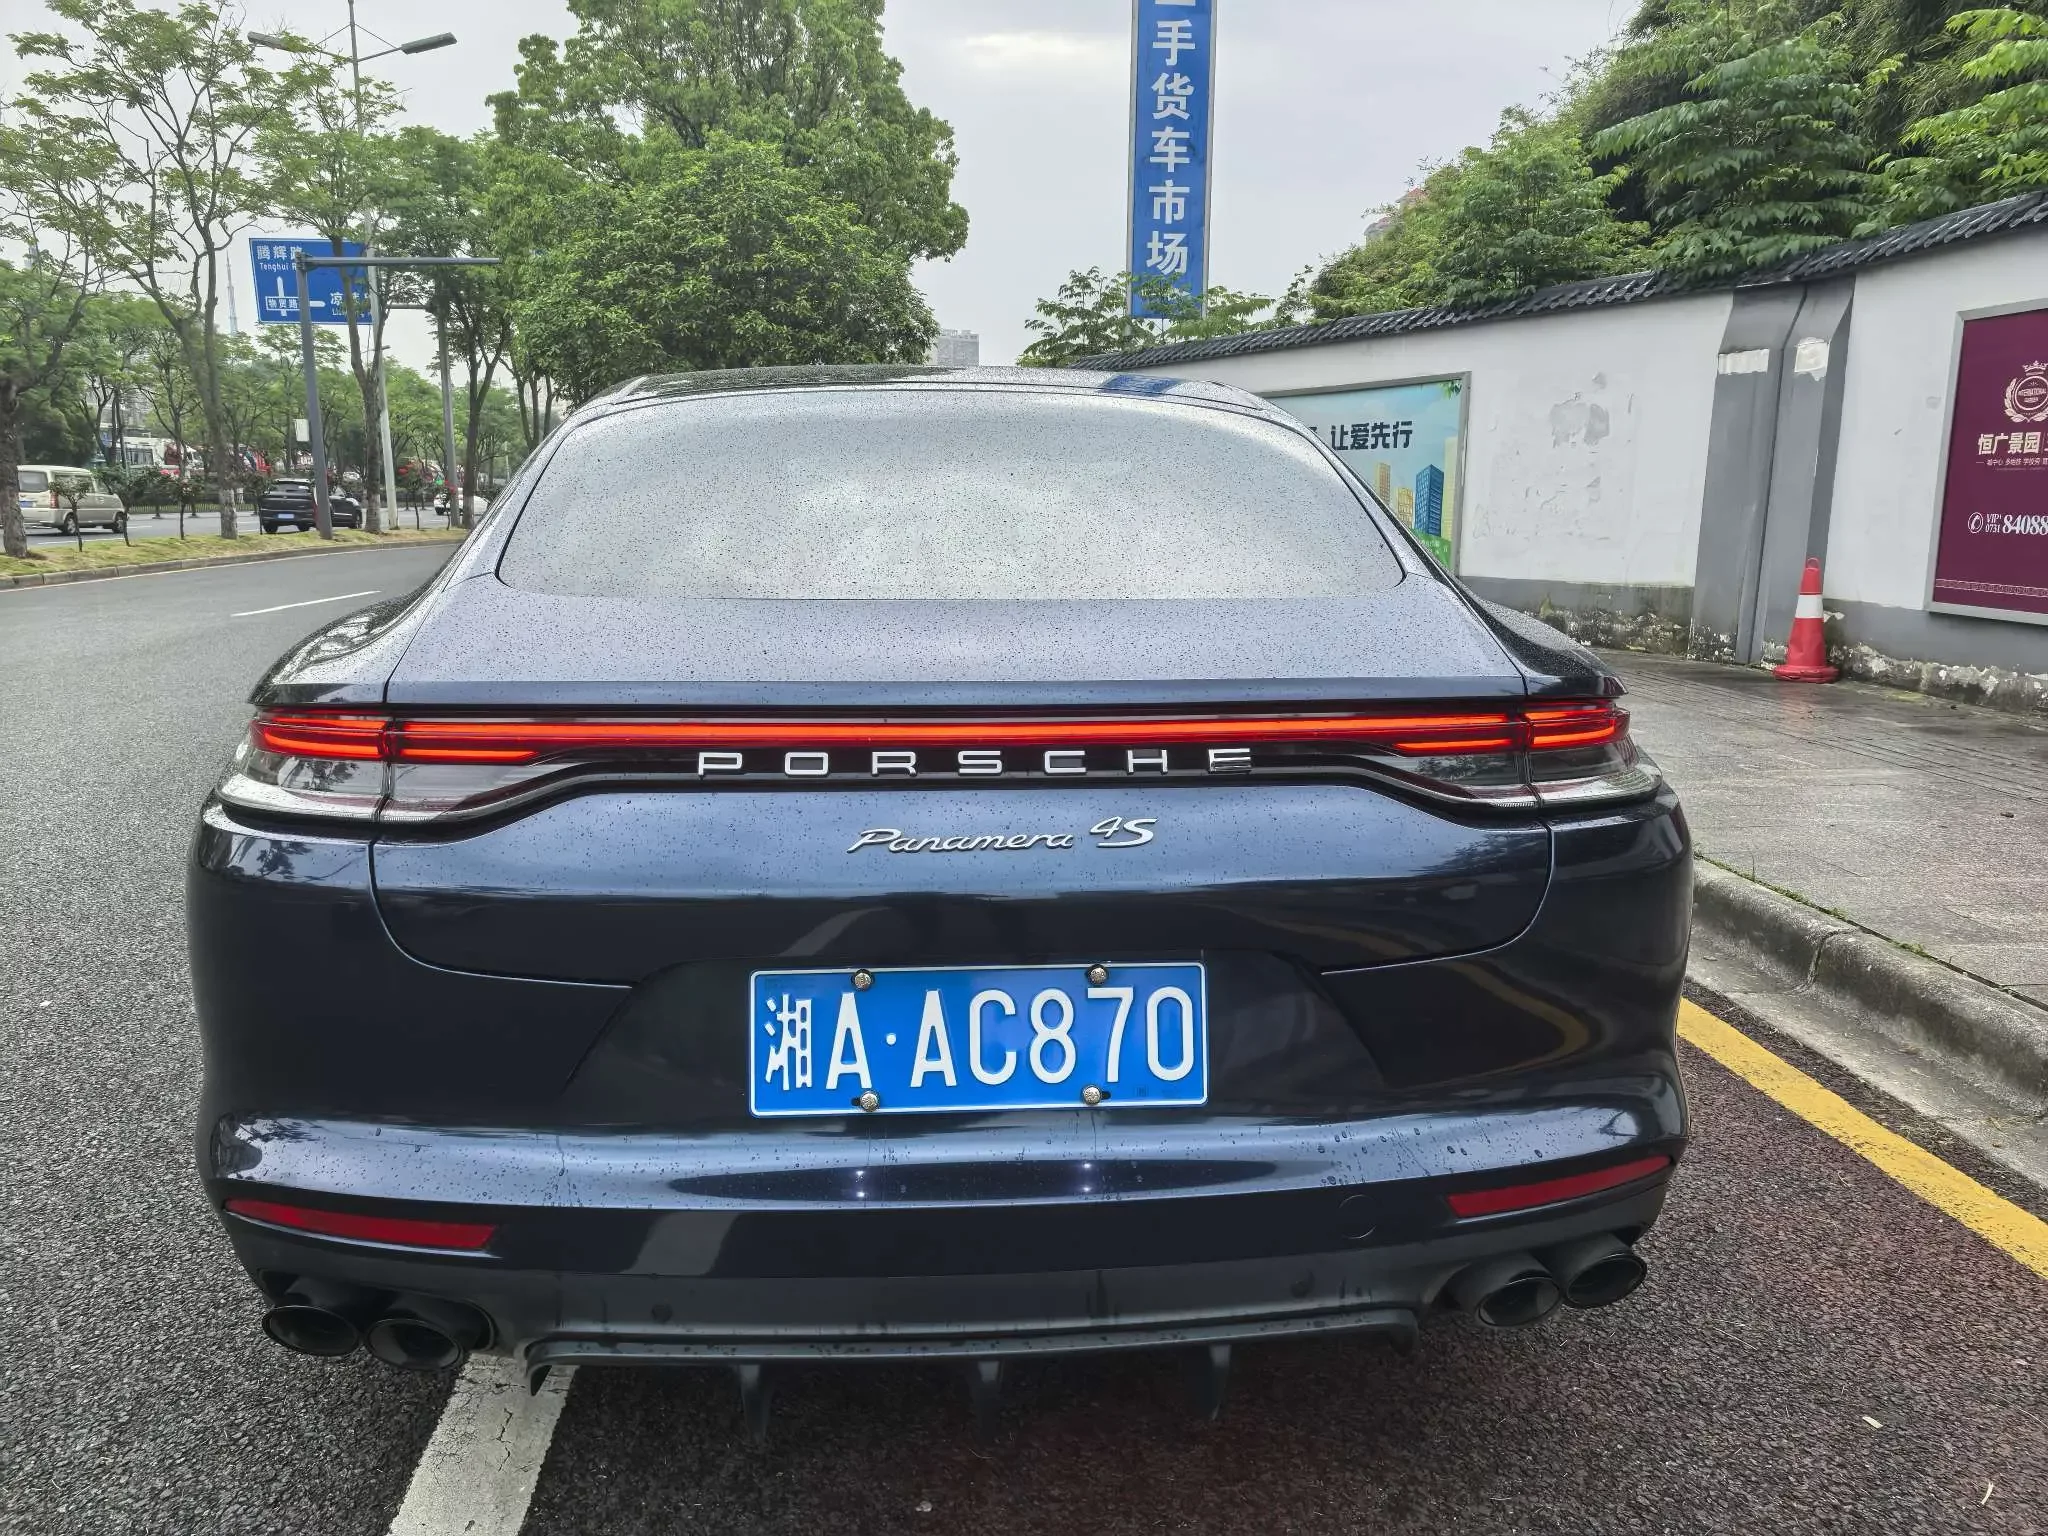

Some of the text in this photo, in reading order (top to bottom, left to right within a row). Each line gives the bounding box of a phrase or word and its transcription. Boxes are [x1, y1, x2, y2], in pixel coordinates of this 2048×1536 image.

[259, 262, 290, 273] Tenghui
[1330, 420, 1413, 451] 让爱先行
[1978, 432, 2041, 455] 恒广景园
[698, 748, 1253, 777] PORSCHE
[847, 816, 1158, 854] Panamera 4S
